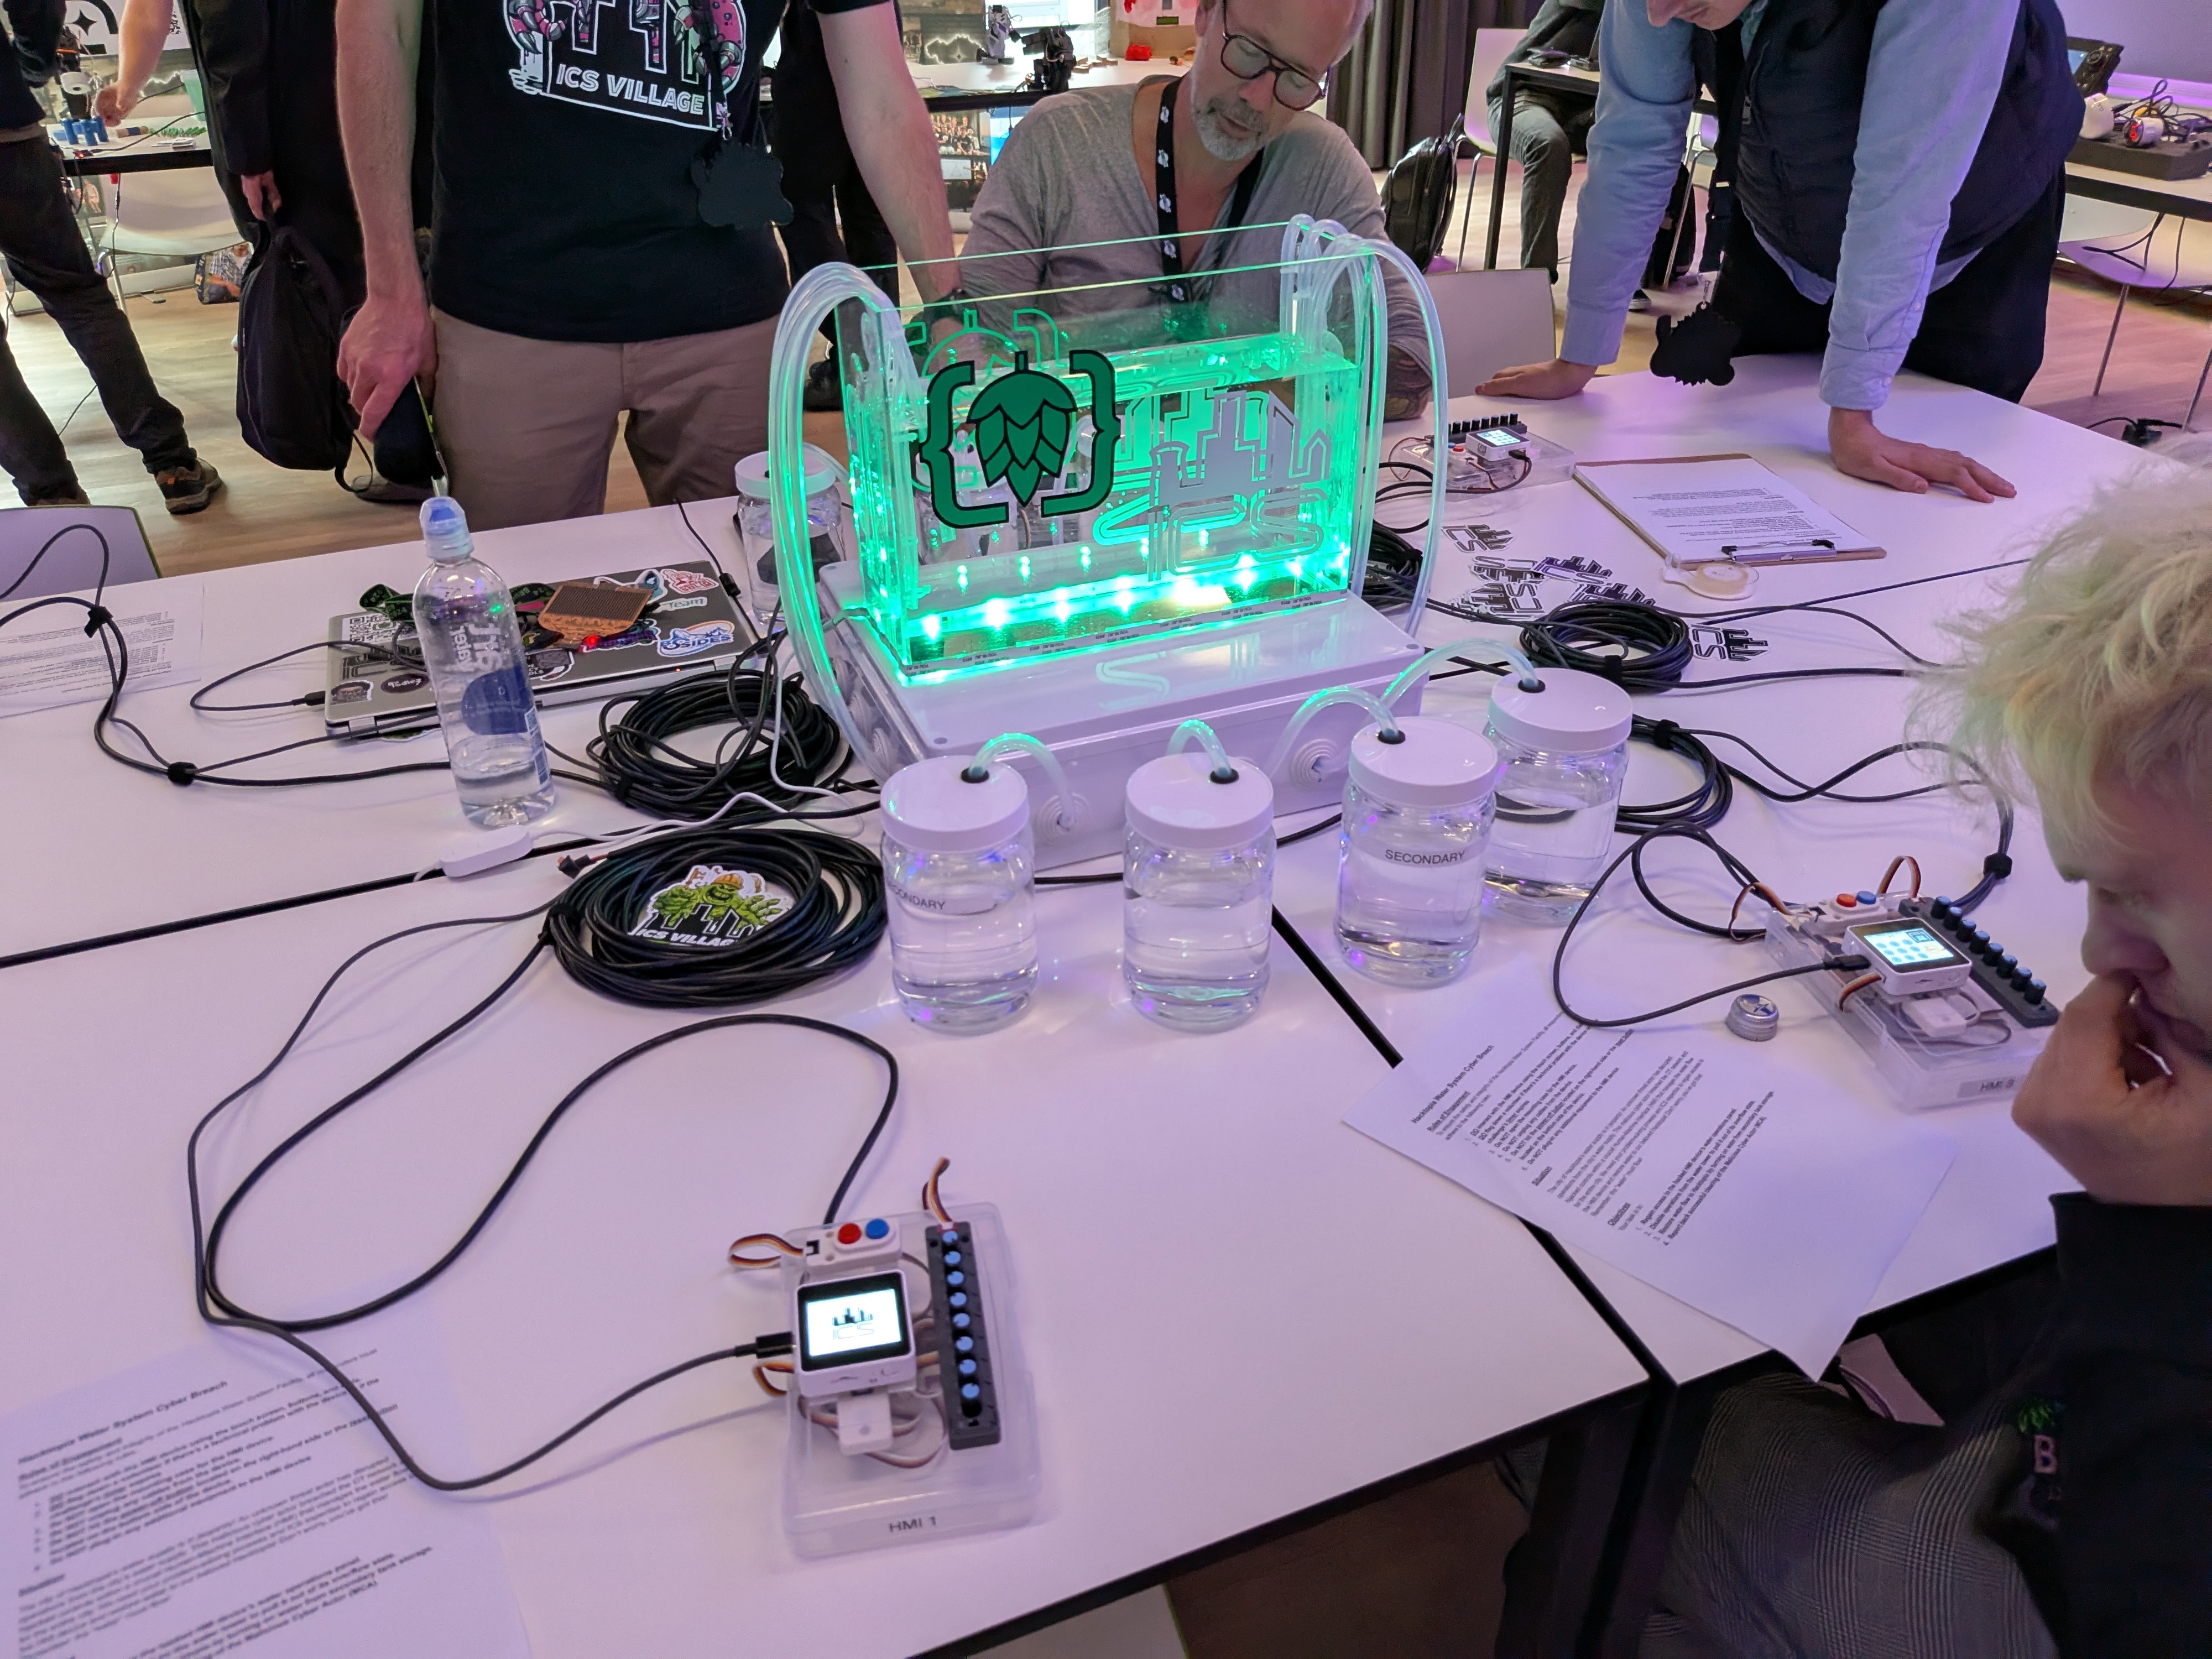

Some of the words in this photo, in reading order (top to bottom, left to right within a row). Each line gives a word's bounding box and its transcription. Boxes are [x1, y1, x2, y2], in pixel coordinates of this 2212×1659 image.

[556, 64, 599, 92] ICS
[606, 74, 705, 116] VILLAGE
[1385, 849, 1465, 865] SECONDARY
[636, 928, 669, 939] ICS
[670, 932, 738, 947] VILLAG
[1410, 1100, 1437, 1124] Hacktopia
[1432, 1087, 1449, 1100] Water
[1446, 1071, 1467, 1088] System
[1463, 1058, 1479, 1072] Cyber
[1475, 1045, 1494, 1060] Breach
[1515, 1139, 1526, 1150] NOT
[833, 1322, 874, 1340] ICS
[155, 1396, 187, 1412] Cyber
[190, 1381, 227, 1399] Breach
[889, 1518, 922, 1533] HMI
[930, 1516, 936, 1526] 1
